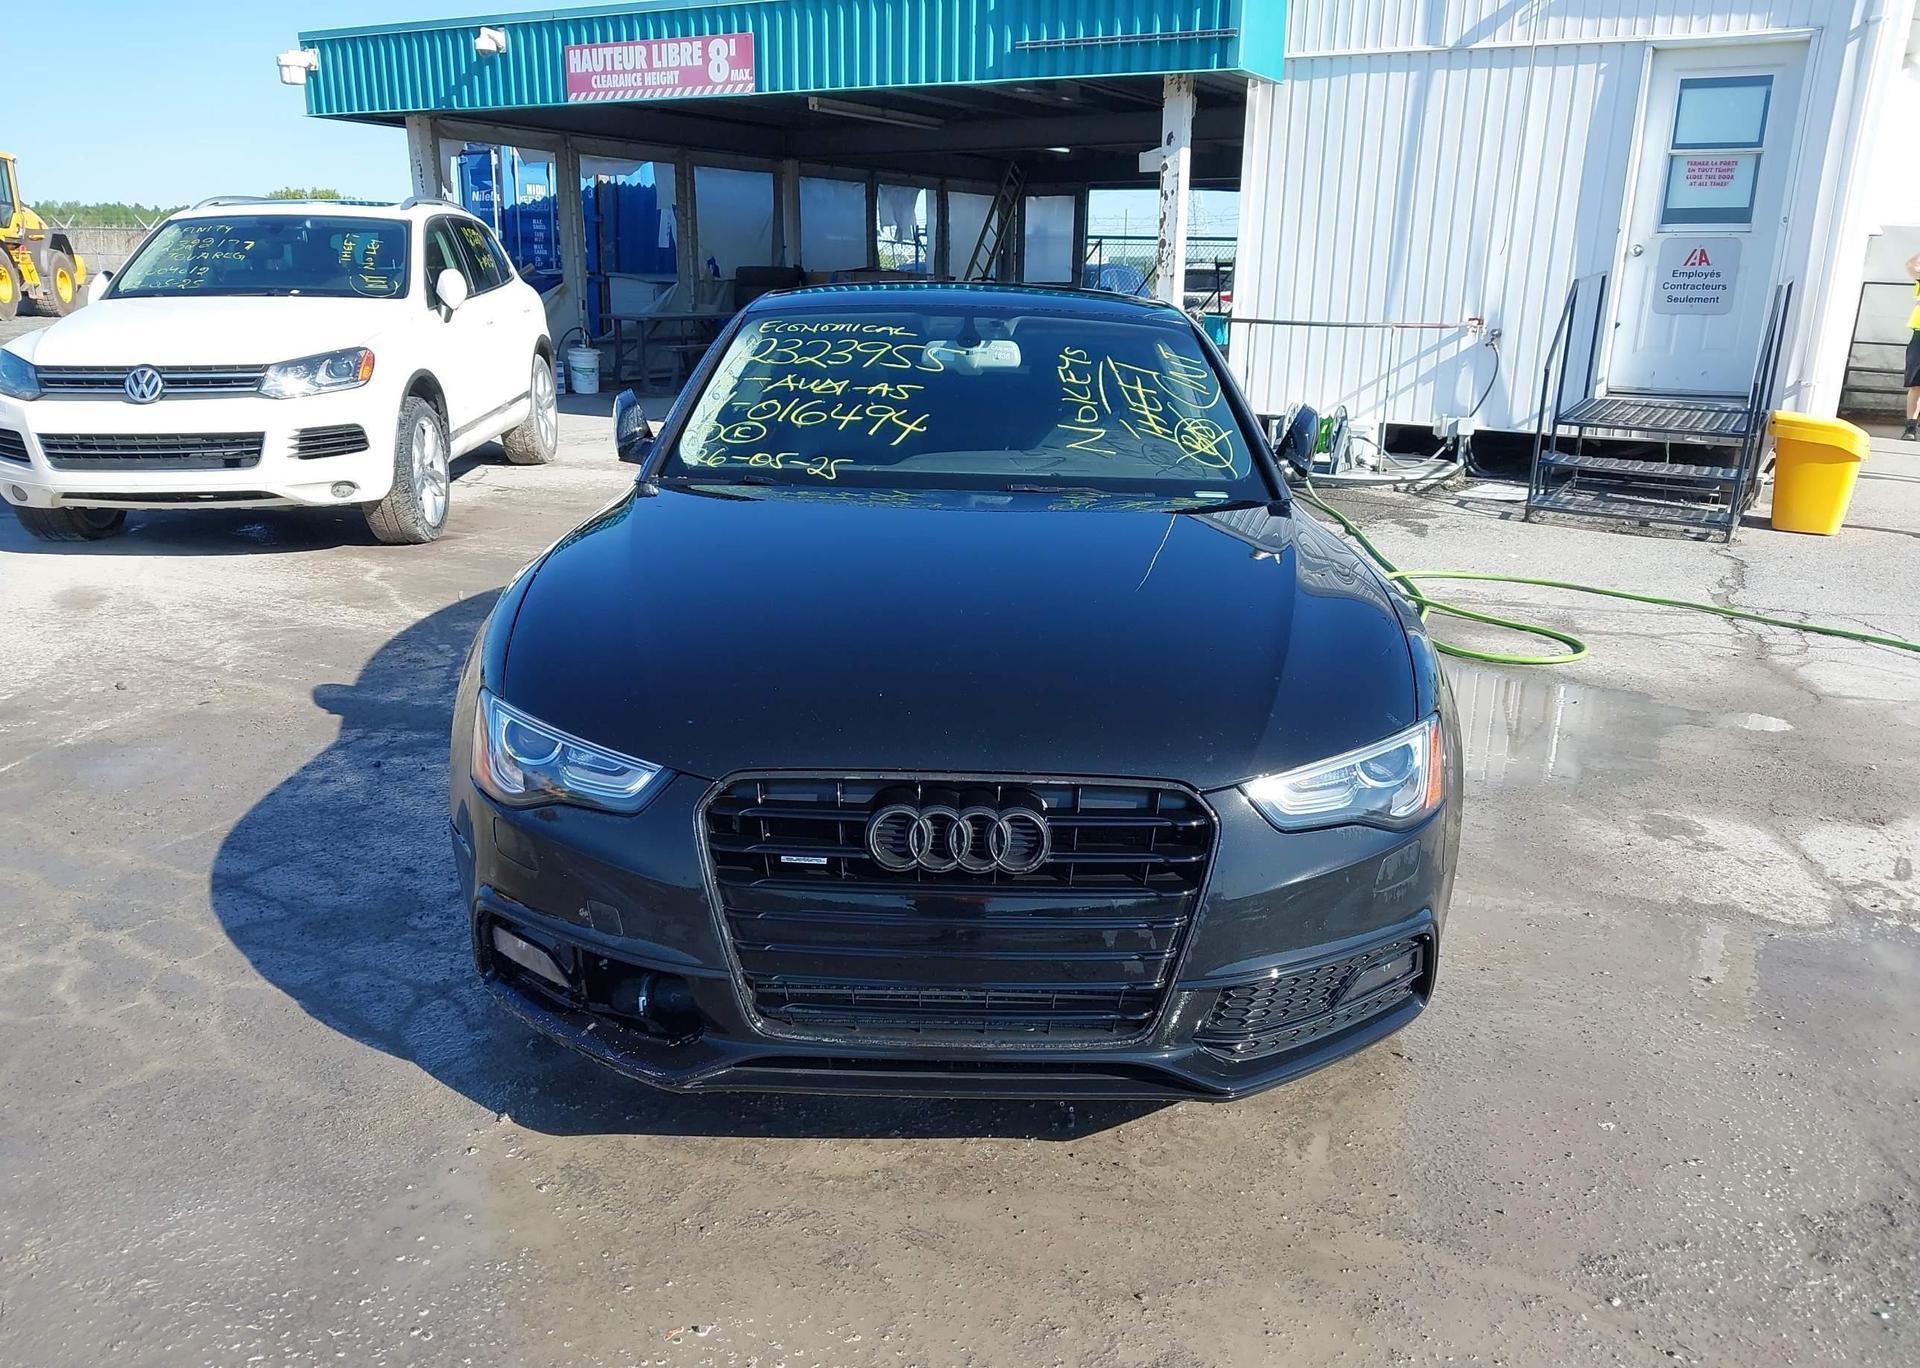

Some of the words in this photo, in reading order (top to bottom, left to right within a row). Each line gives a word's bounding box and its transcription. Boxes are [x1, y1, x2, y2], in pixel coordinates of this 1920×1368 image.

[569, 45, 648, 74] HAUTEUR
[652, 41, 703, 69] LIBRE
[591, 72, 642, 89] CLEARANCE
[645, 70, 680, 87] HEIGHT
[730, 68, 753, 82] MAX.
[1672, 269, 1721, 280] Employés
[1662, 281, 1728, 291] Contracteurs
[1666, 294, 1720, 304] Seulement
[758, 320, 918, 337] ECONOMICAL
[746, 337, 967, 373] 2323955
